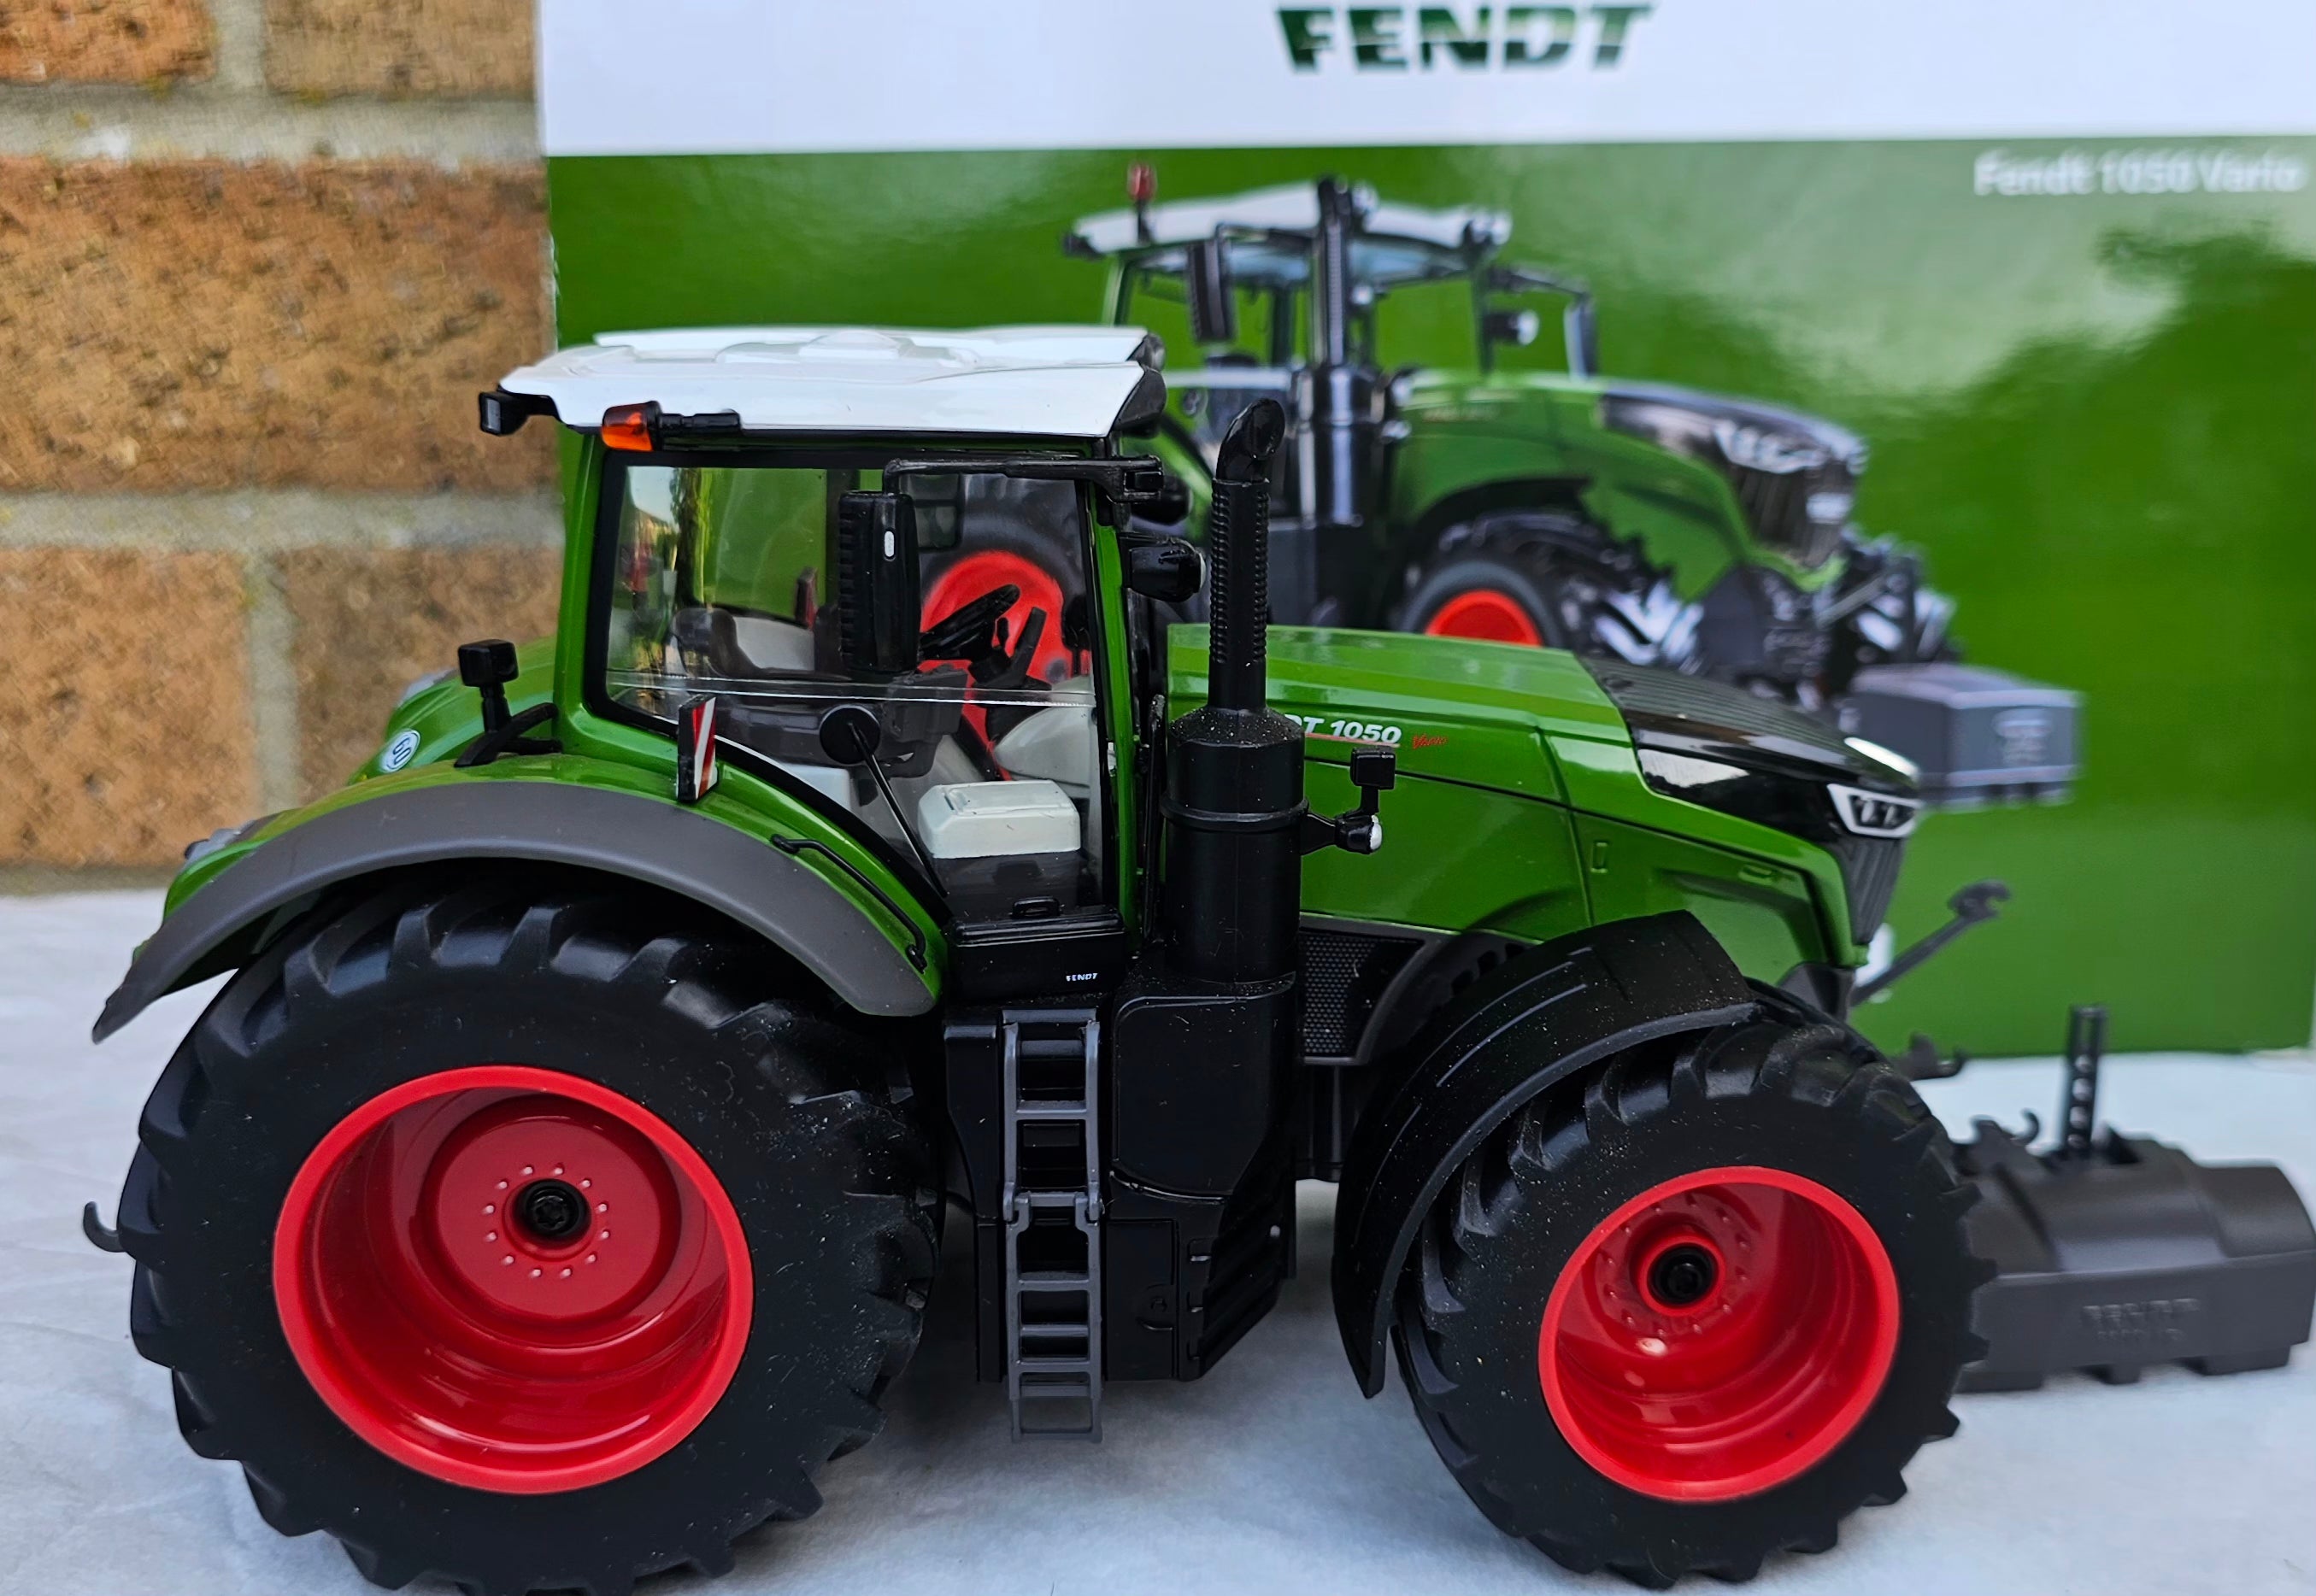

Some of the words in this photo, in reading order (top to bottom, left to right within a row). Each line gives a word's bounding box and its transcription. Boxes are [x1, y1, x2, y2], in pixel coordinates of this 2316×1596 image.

[1276, 8, 1654, 71] FENDT
[1974, 150, 2096, 196] Fendt
[2098, 149, 2197, 194] 1050
[2197, 147, 2306, 192] Vario
[1331, 719, 1402, 745] 1050
[1066, 973, 1098, 982] FENDT
